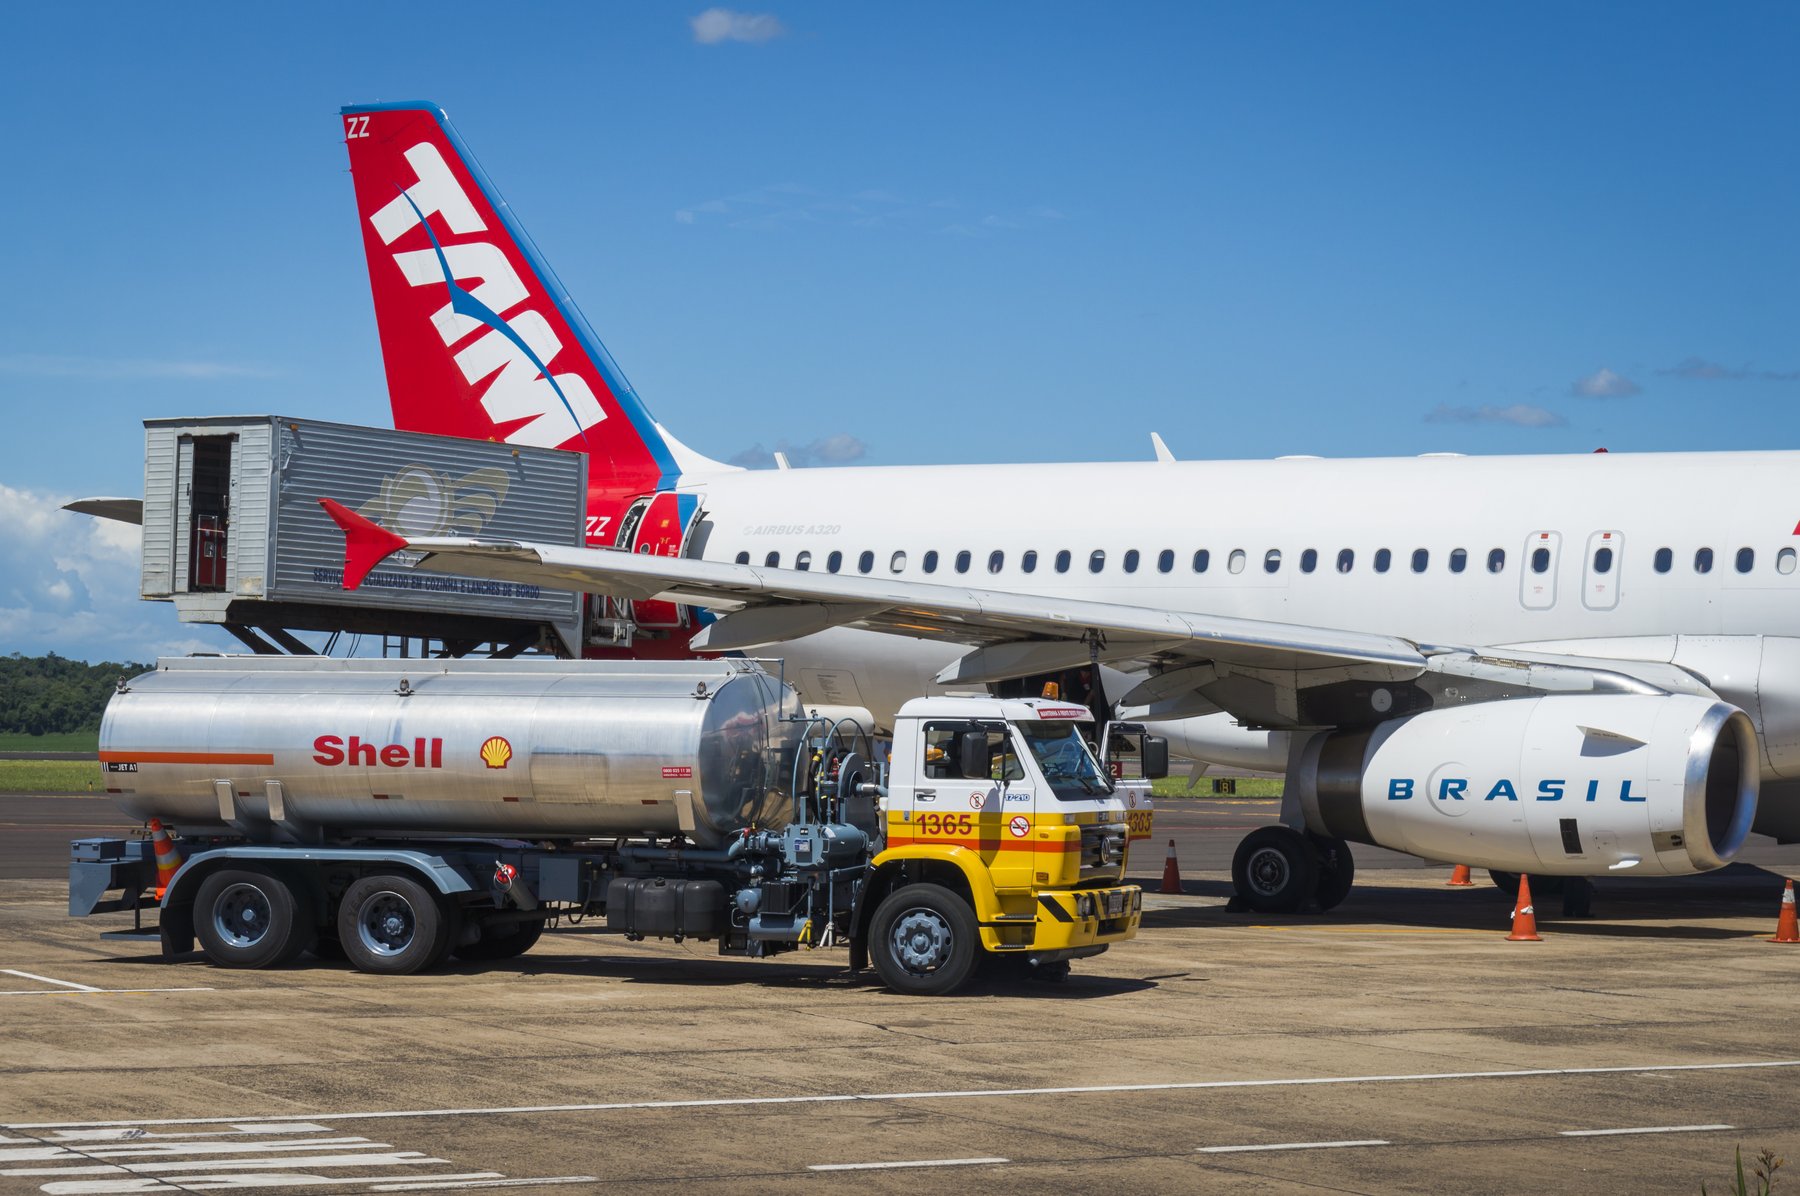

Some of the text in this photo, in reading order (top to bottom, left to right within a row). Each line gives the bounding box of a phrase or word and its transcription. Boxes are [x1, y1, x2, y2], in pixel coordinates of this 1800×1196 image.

[347, 116, 370, 139] ZZ
[369, 141, 608, 450] TAM
[752, 524, 842, 536] AIRBUS A320
[313, 567, 344, 586] SERVIÇ
[425, 577, 458, 593] COZINHA
[467, 580, 501, 596] LANCHES
[502, 583, 512, 597] DE
[515, 584, 540, 599] BORDO
[313, 734, 443, 768] Shell
[118, 763, 128, 771] JET
[129, 763, 137, 771] A1
[1387, 778, 1647, 803] BRASIL
[916, 814, 973, 836] 1365
